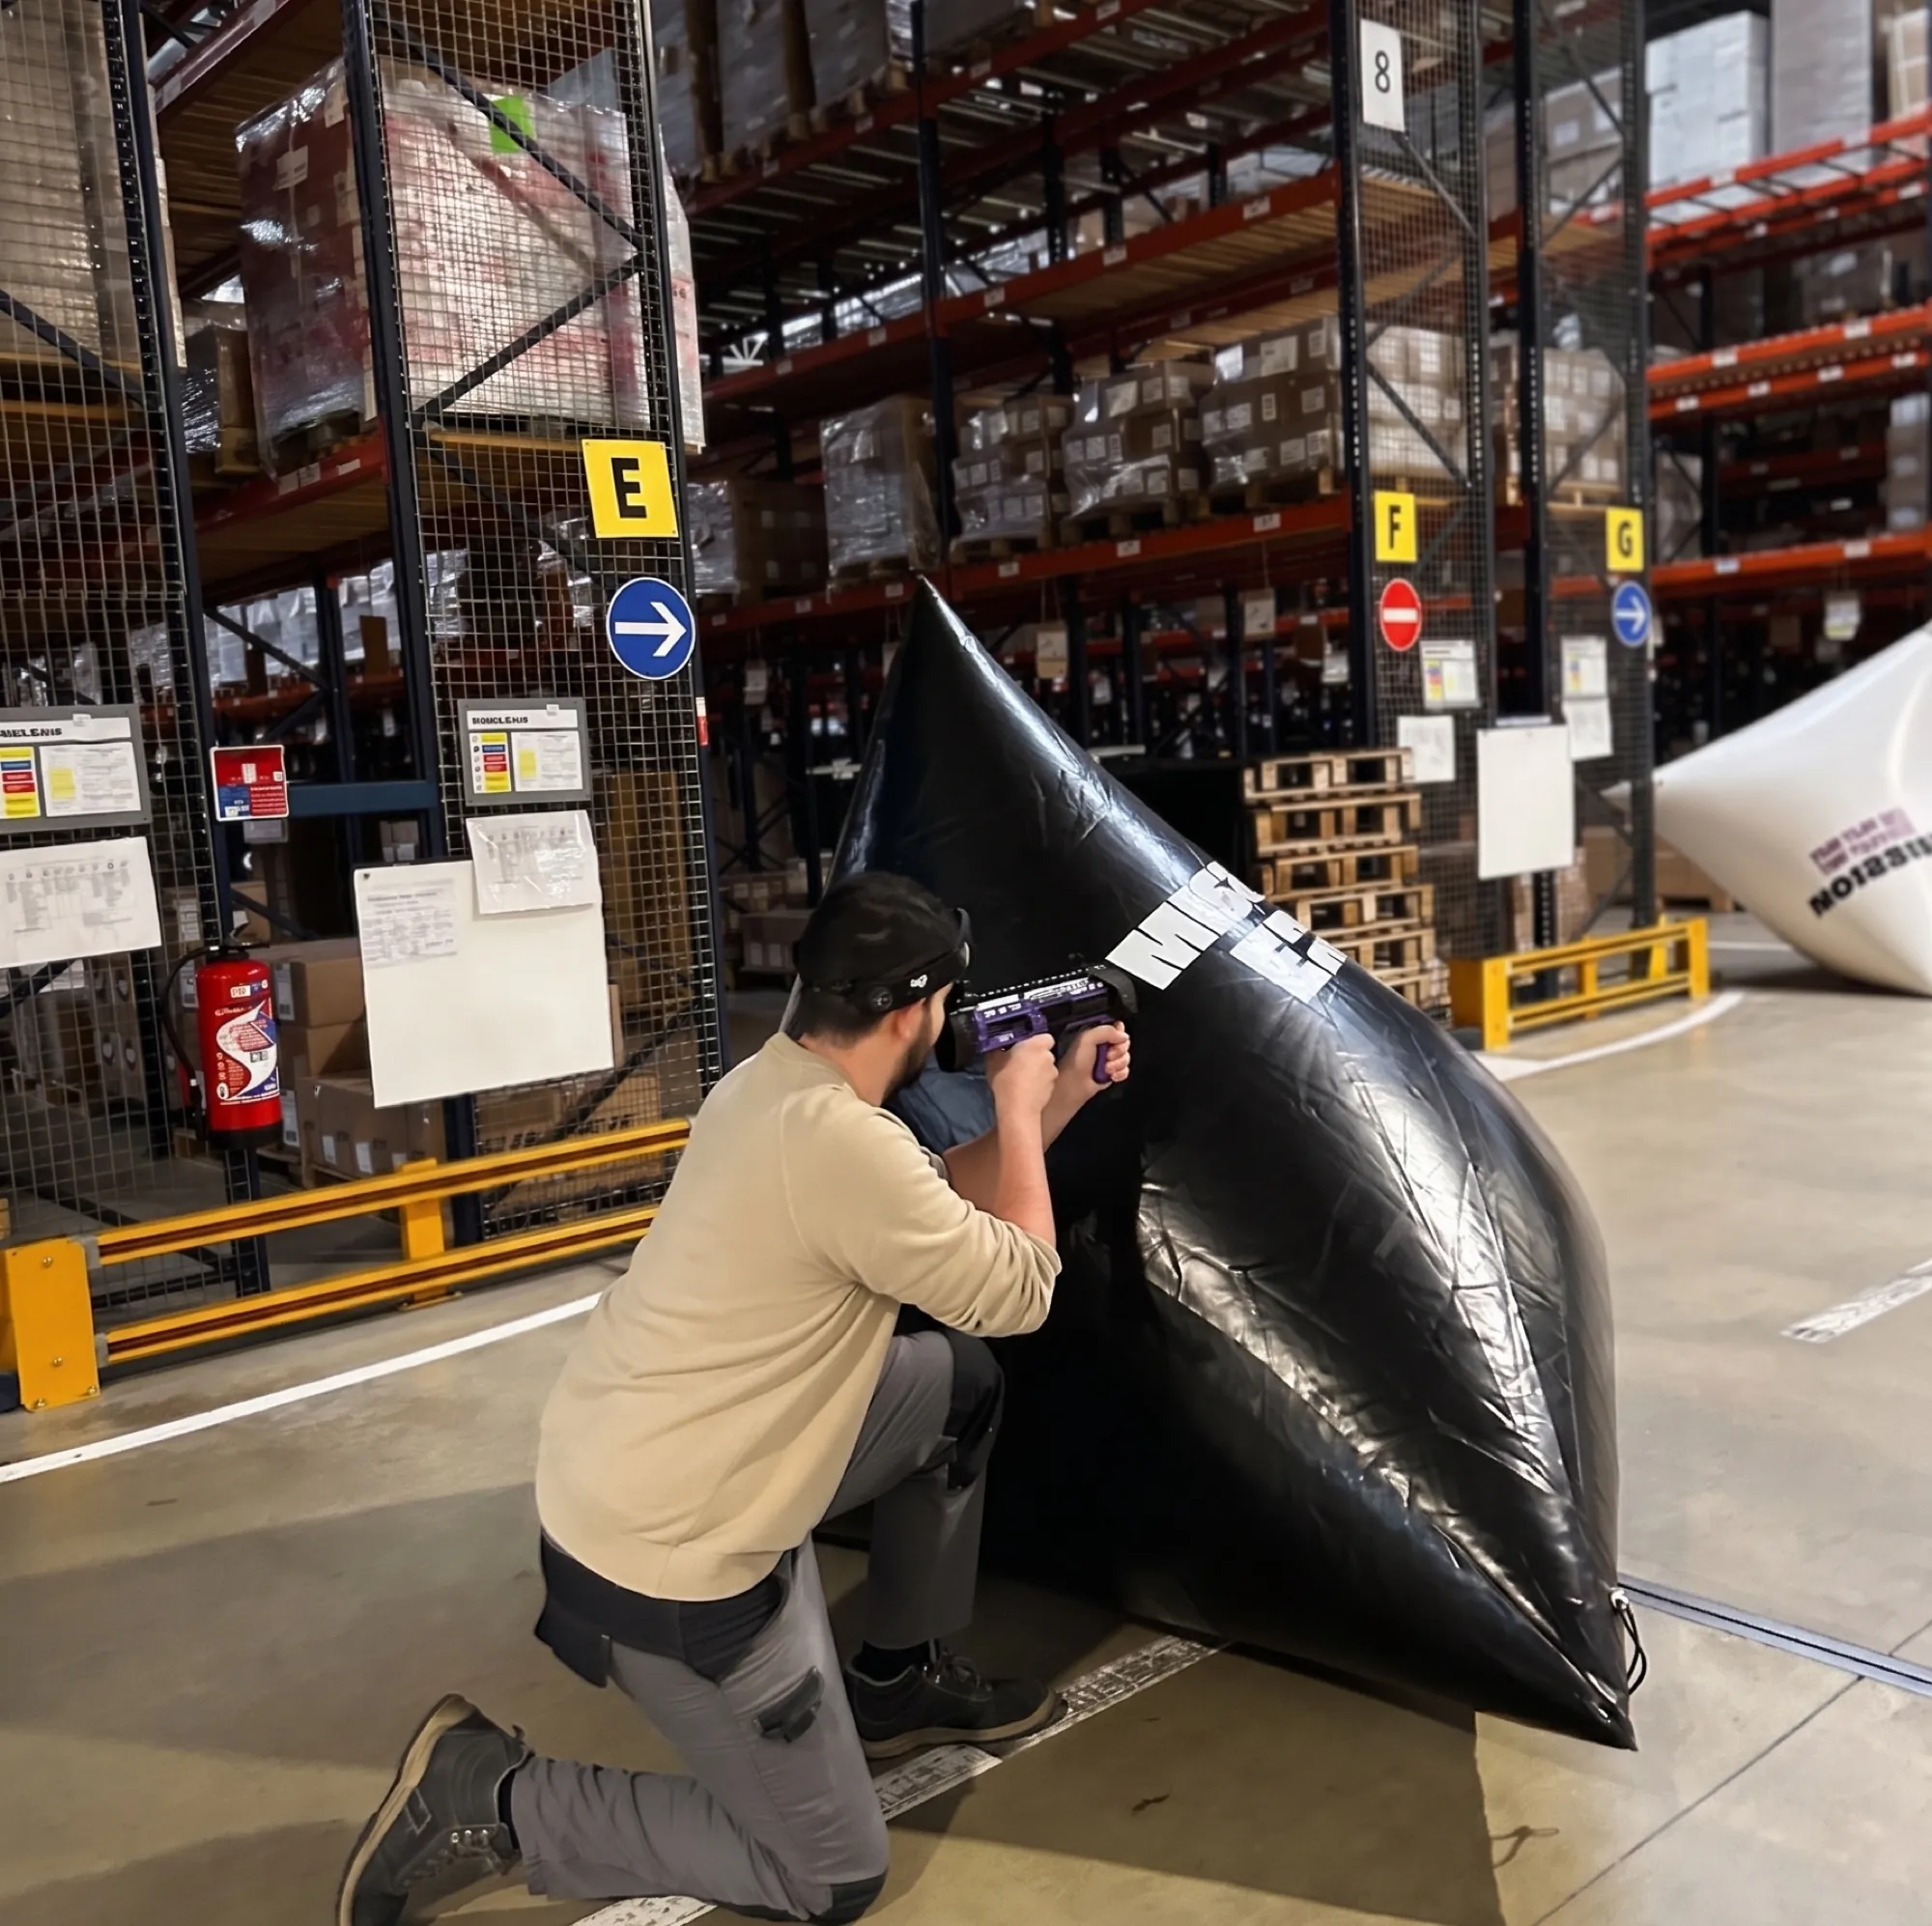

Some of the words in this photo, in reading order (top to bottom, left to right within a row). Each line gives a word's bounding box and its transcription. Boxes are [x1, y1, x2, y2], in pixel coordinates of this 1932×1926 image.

[1375, 49, 1391, 94] 8
[611, 457, 647, 519] E
[1389, 505, 1401, 550] F
[1617, 521, 1633, 558] G
